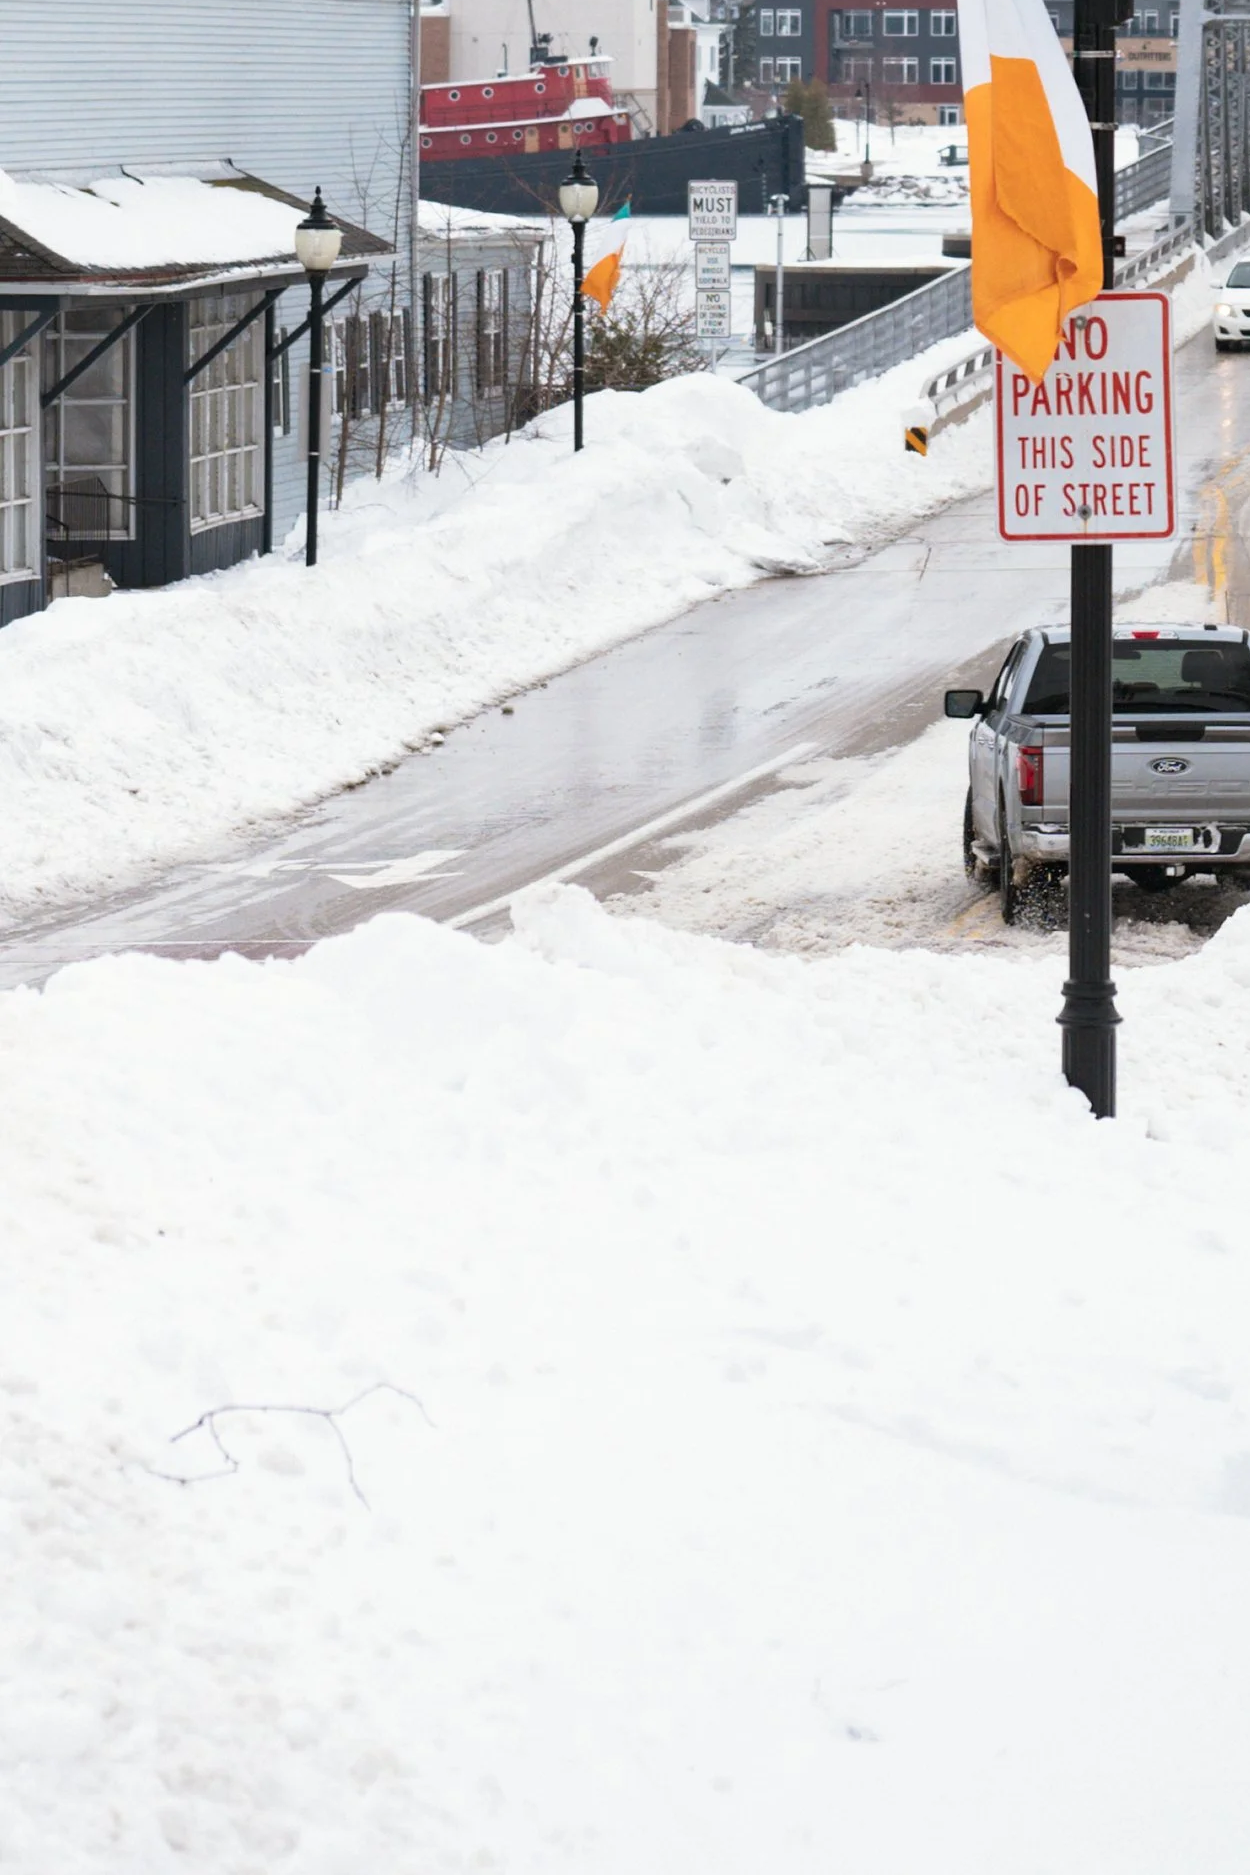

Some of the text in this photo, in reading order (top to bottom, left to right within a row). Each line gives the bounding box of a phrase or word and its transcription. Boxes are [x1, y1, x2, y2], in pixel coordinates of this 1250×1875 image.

[689, 185, 737, 195] BICYCLISTS
[693, 197, 733, 213] MUST
[695, 216, 731, 225] YIELD TO
[692, 227, 735, 236] PEDESTRIANS
[706, 294, 720, 303] NO
[1054, 316, 1109, 361] NO
[1012, 371, 1154, 416] PARKING
[1018, 435, 1152, 469] THIS SIDE
[1015, 483, 1155, 517] OF STREET
[1157, 760, 1184, 773] Ford
